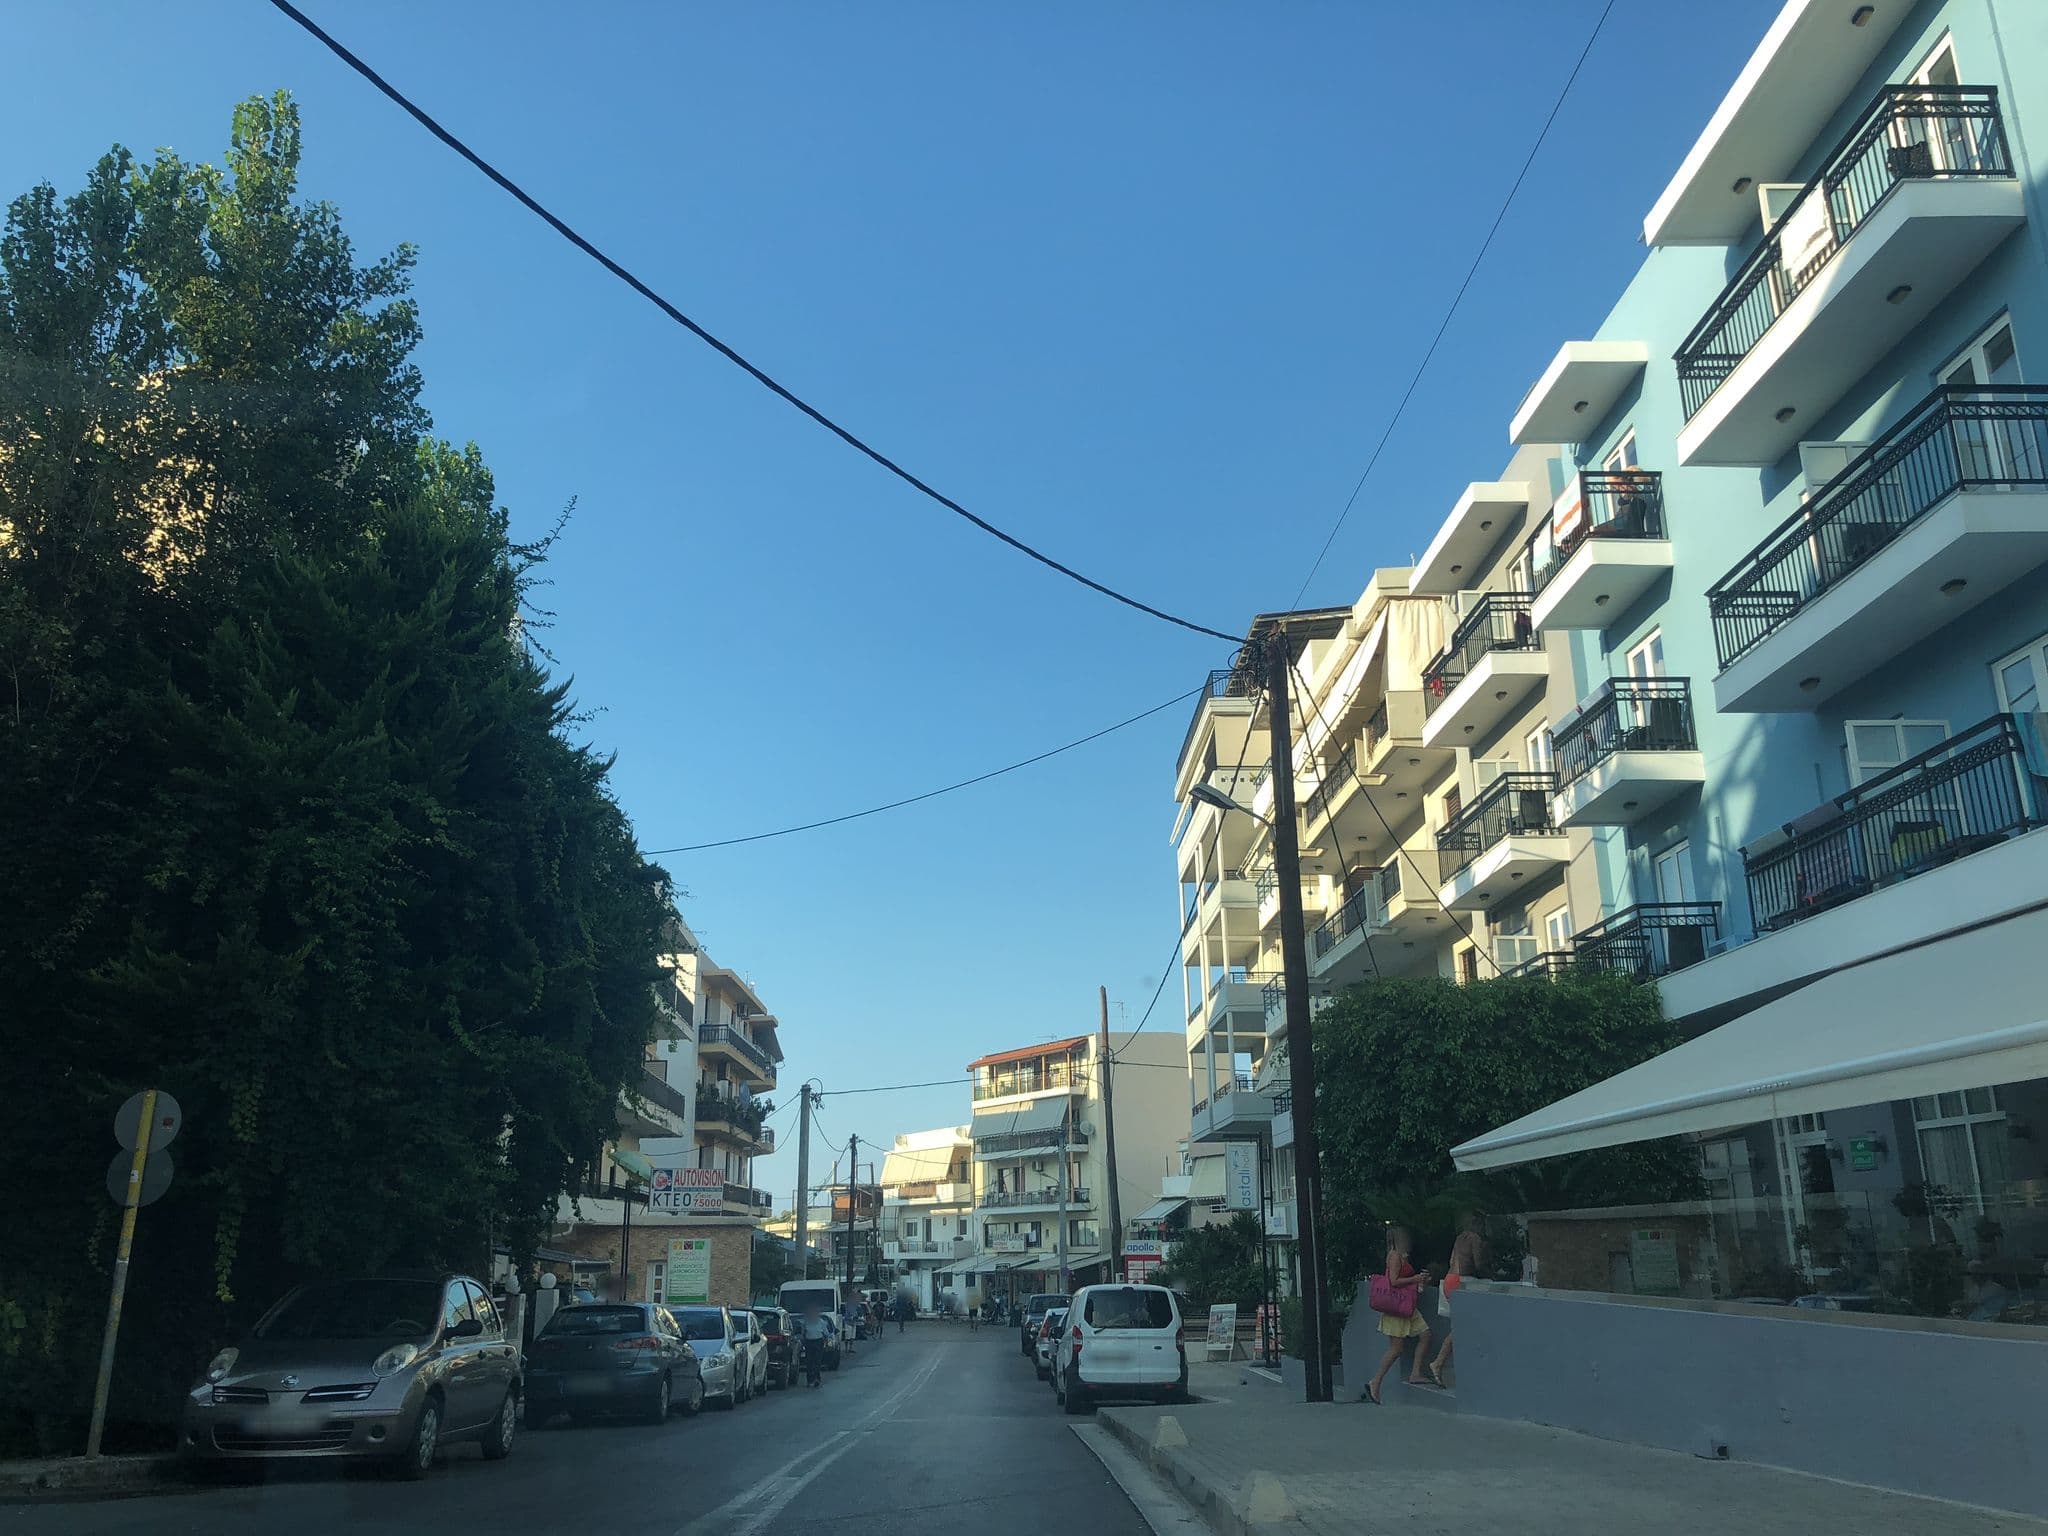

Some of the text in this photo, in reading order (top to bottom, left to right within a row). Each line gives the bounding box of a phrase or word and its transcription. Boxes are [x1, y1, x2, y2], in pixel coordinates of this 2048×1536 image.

[674, 1169, 724, 1186] AUTOVISION
[693, 1198, 722, 1207] 75000
[1127, 1243, 1154, 1253] apollo
